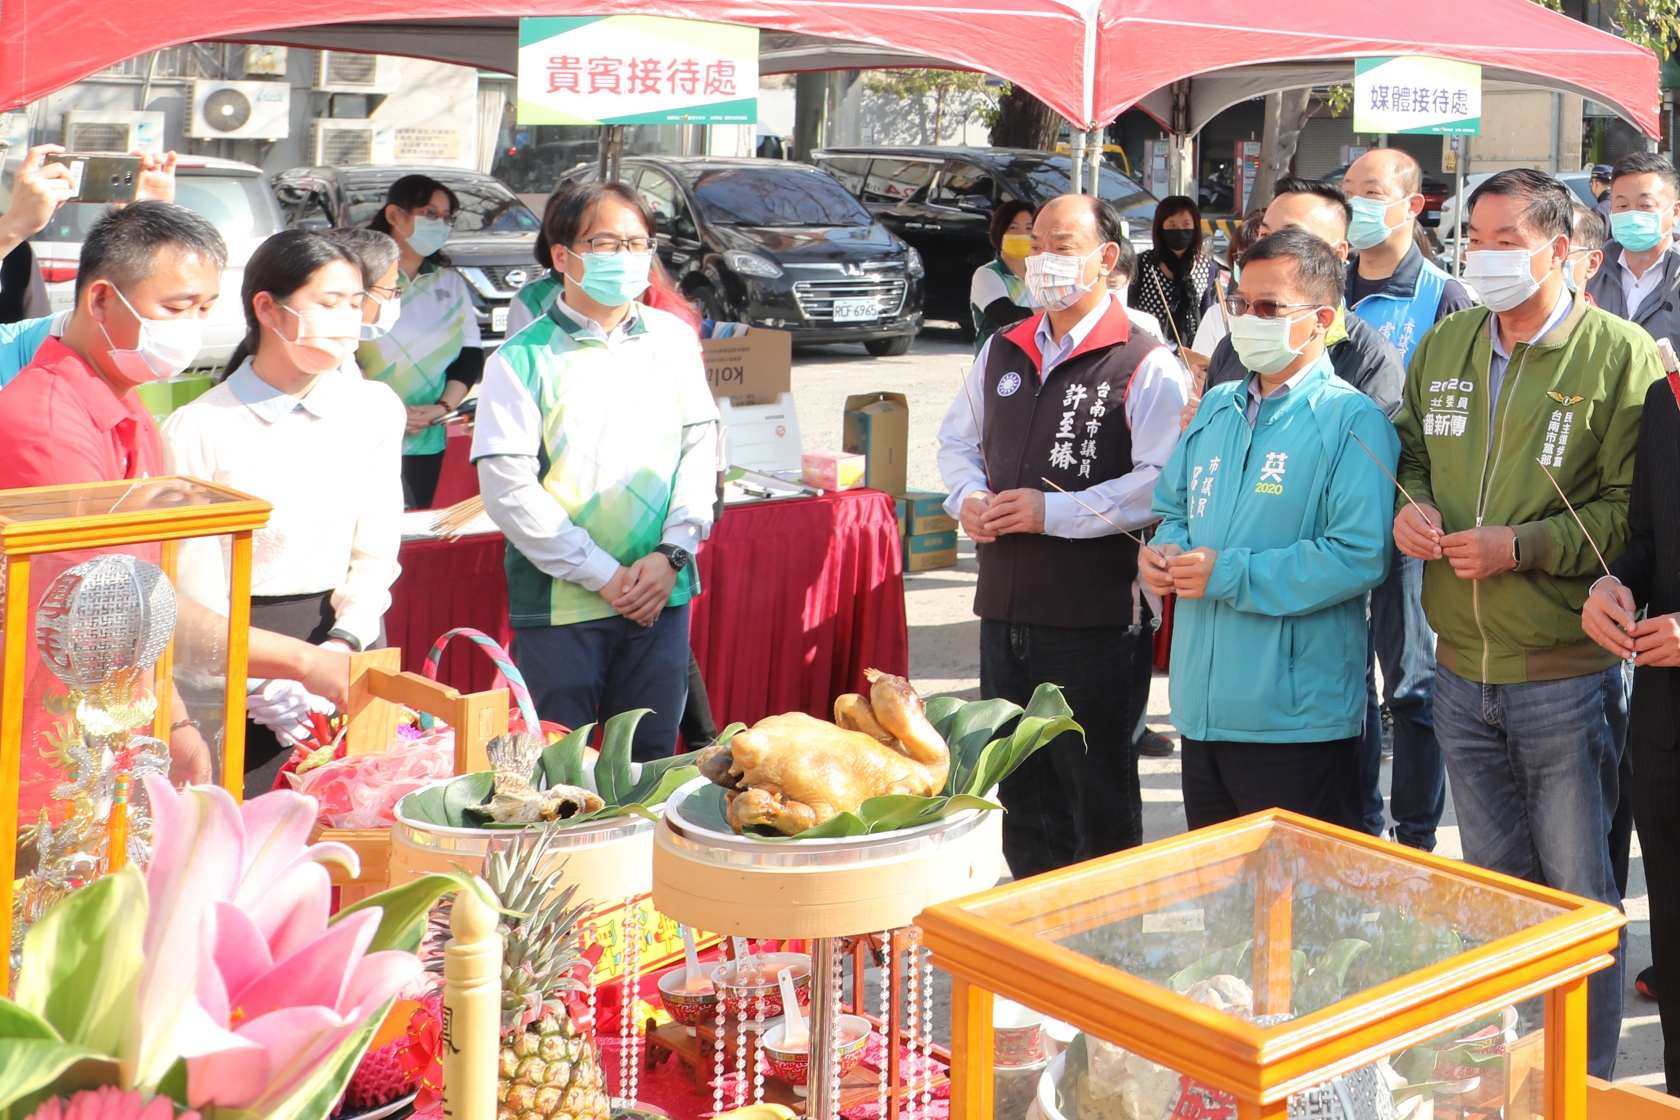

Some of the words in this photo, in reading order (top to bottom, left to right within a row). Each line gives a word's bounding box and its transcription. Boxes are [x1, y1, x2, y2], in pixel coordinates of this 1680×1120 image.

[546, 55, 737, 96] 貴賓接待處
[1371, 85, 1468, 115] 媒體接待處
[1048, 383, 1088, 471] 許至椿
[1077, 381, 1111, 479] 台南市議員
[1423, 414, 1467, 437] 潘新傳
[1540, 409, 1562, 467] 台南市黨部
[1553, 412, 1573, 467] 民主進步黨
[1197, 456, 1221, 517] 市議員
[1255, 482, 1283, 495] 2020
[1260, 452, 1288, 483] 英
